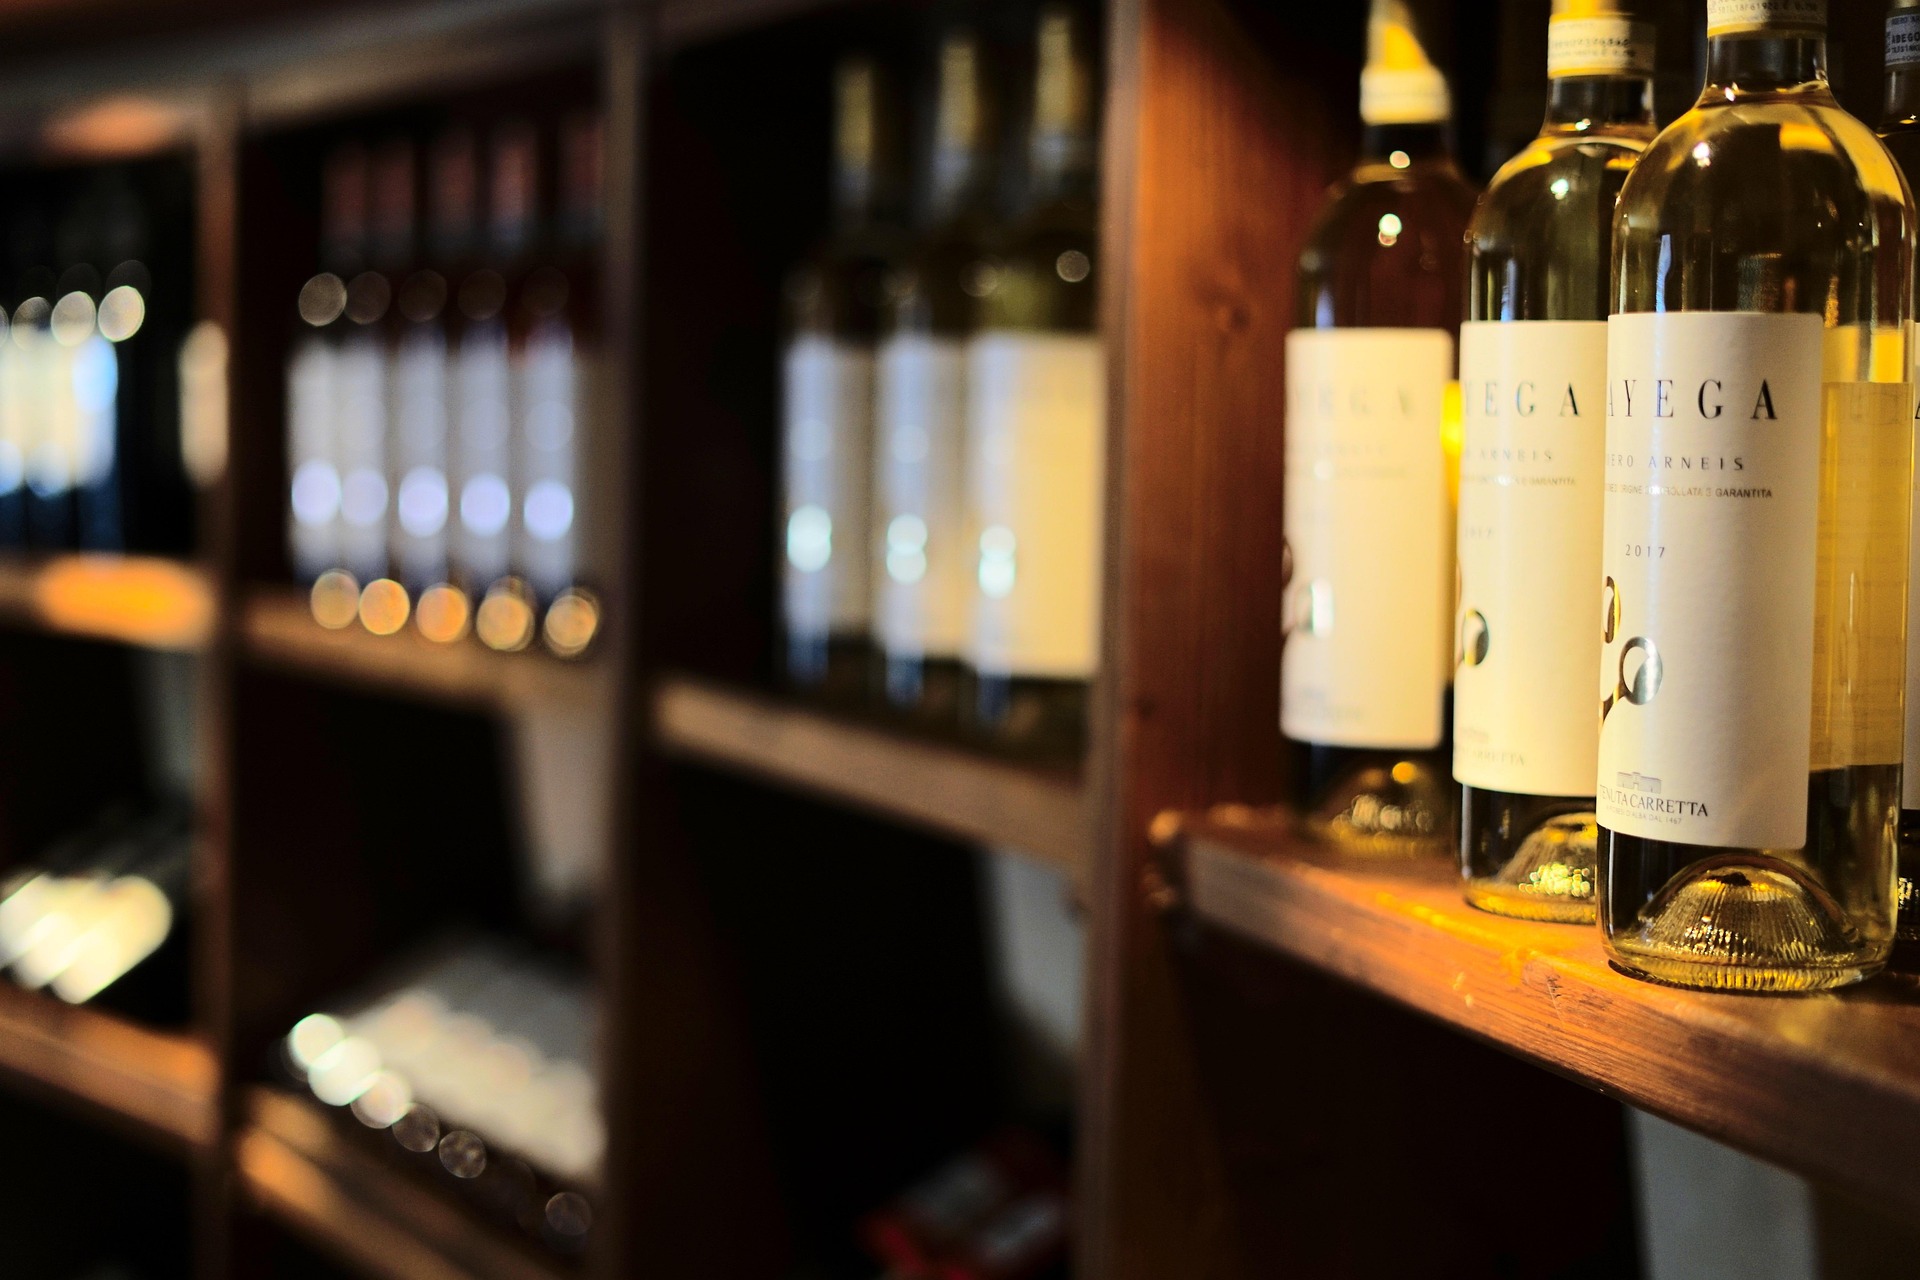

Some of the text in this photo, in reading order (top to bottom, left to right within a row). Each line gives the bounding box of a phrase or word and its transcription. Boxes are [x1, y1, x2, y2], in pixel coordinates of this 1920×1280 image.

[1648, 456, 1744, 471] ARNEIS
[1715, 487, 1773, 499] GARANTITA
[1625, 544, 1665, 558] 2017
